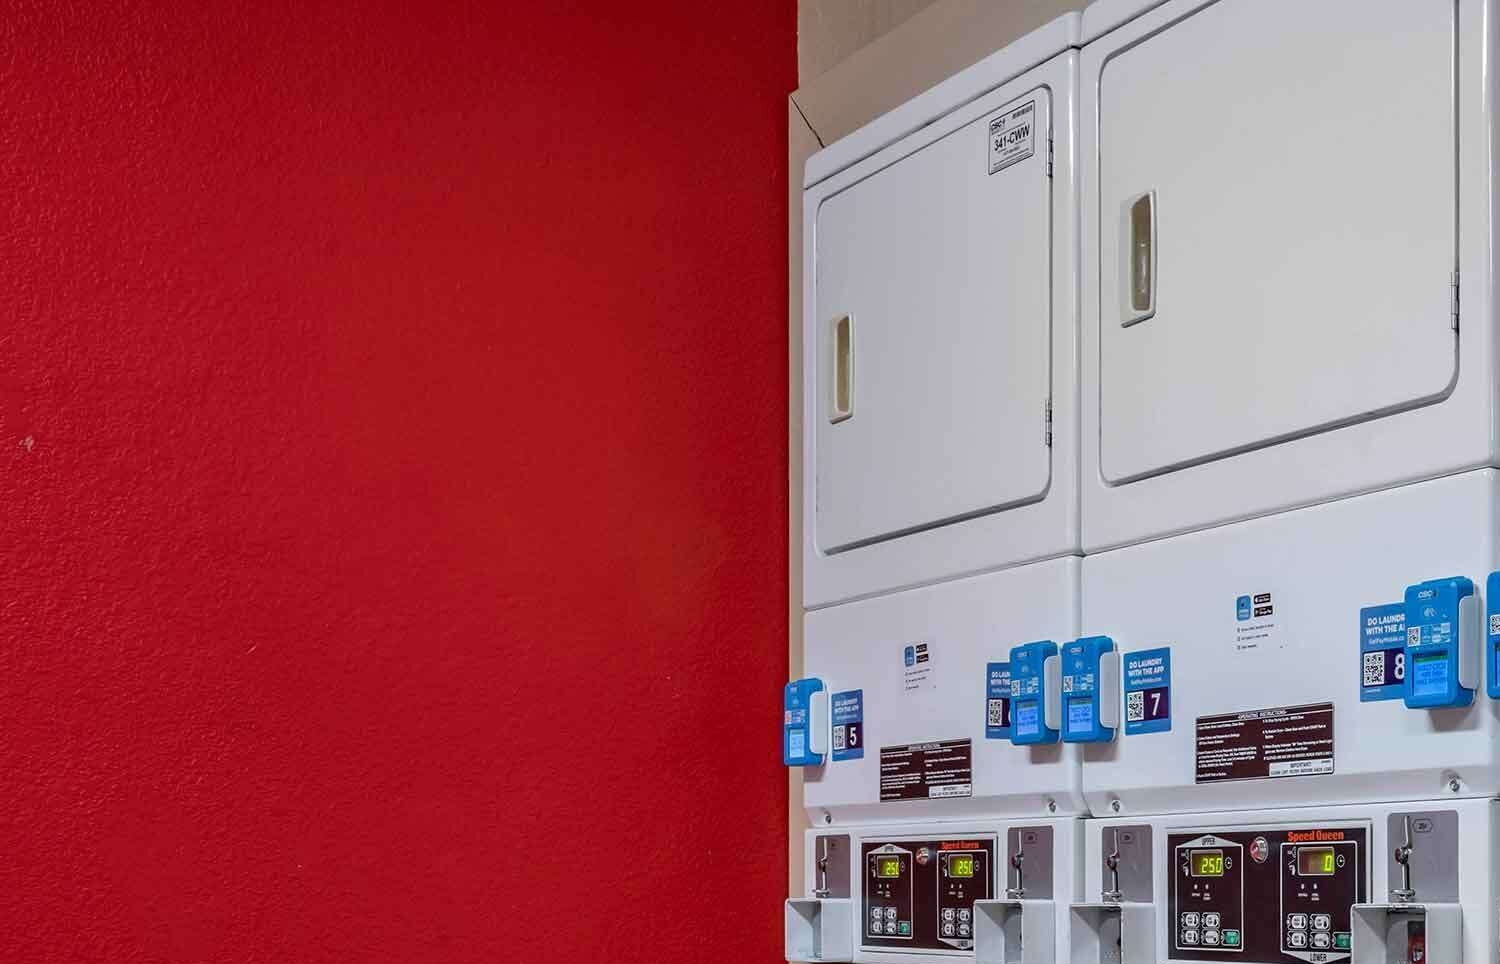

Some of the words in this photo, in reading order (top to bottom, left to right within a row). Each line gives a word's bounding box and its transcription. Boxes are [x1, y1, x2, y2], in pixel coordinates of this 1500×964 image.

[995, 124, 1029, 151] 341-CWW
[1368, 618, 1377, 626] DO
[1379, 613, 1405, 624] LAUND
[1366, 627, 1383, 635] WITH
[1394, 653, 1405, 679] 8
[1152, 693, 1160, 716] 7
[850, 727, 856, 746] 5
[1288, 832, 1314, 842] Speed
[1316, 831, 1344, 840] Queen
[1324, 855, 1333, 872] 0
[1310, 954, 1327, 962] LOWER
